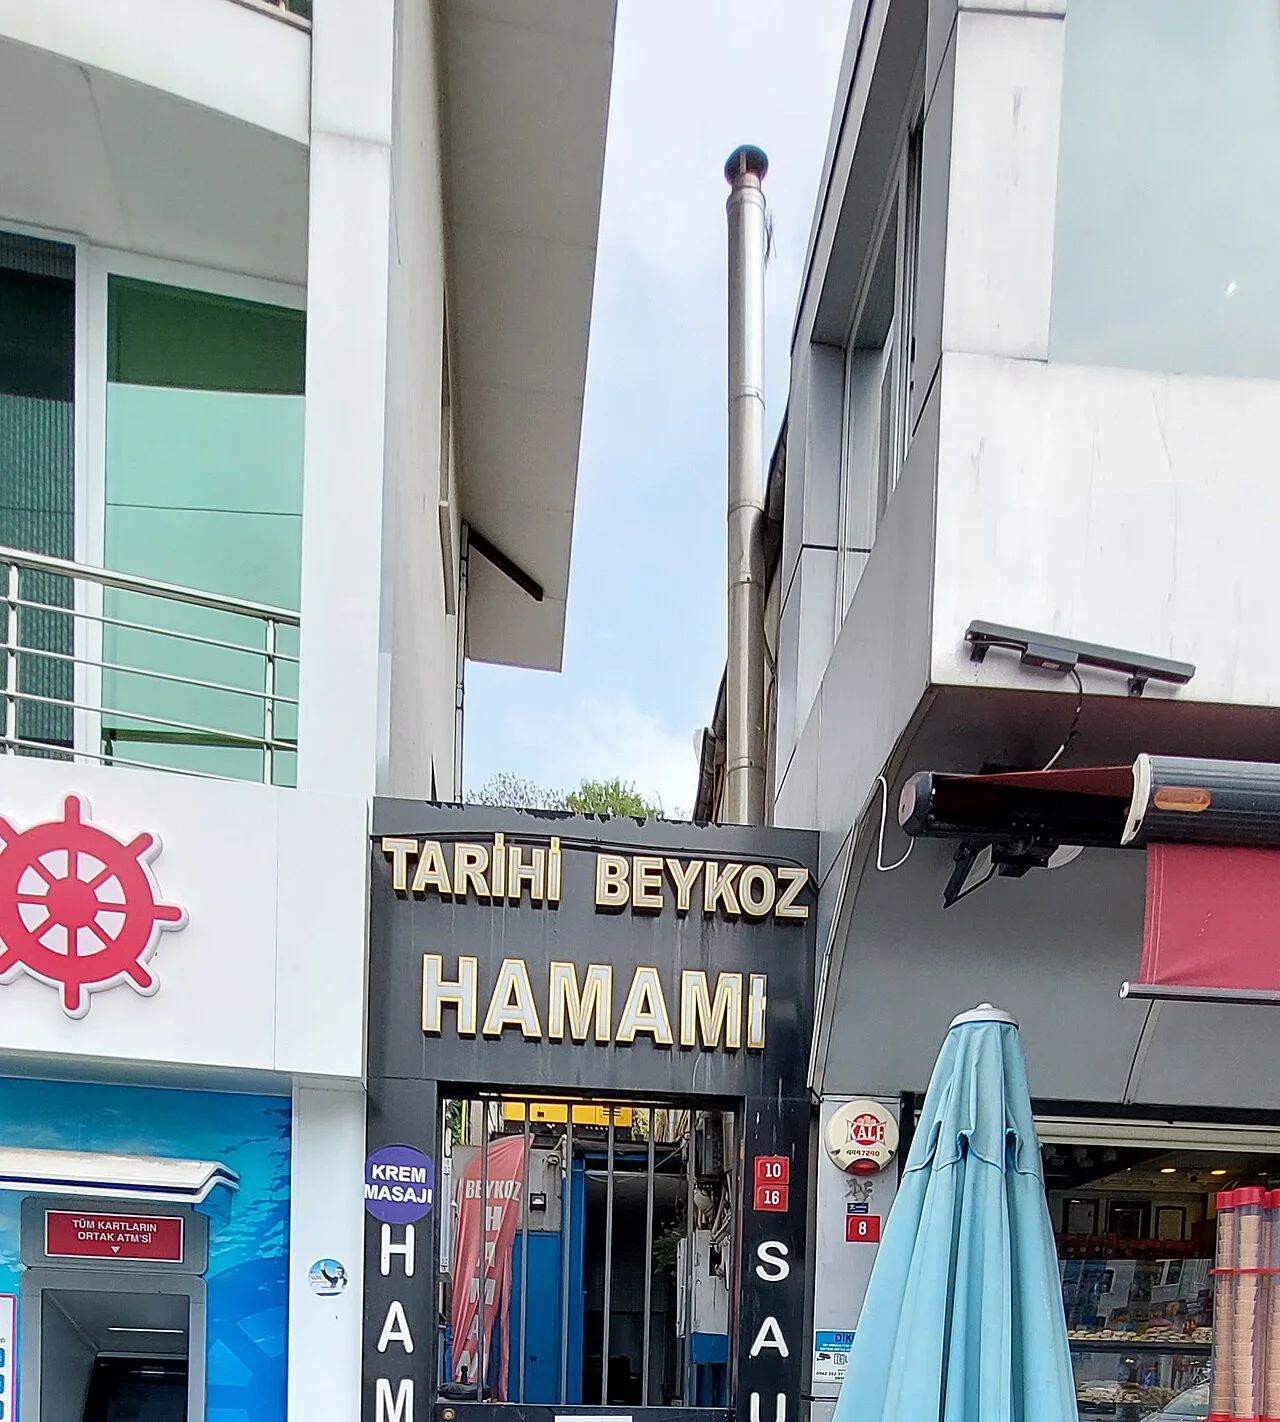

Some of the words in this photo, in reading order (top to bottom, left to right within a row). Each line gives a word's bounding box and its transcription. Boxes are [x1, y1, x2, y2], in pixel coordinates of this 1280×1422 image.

[382, 833, 562, 902] TARİHİ
[596, 854, 810, 919] BEYKOZ
[421, 953, 767, 1049] HAMAMI
[846, 1120, 887, 1145] KALE
[371, 1164, 427, 1184] KREM
[765, 1163, 782, 1178] 10
[363, 1183, 433, 1204] MASAJI
[465, 1179, 522, 1201] BEYKOZ
[763, 1190, 780, 1205] 16
[72, 1217, 95, 1229] TÜM
[97, 1221, 157, 1232] KARTLARIN
[858, 1220, 867, 1236] 8
[77, 1231, 114, 1242] ORTAK
[116, 1232, 152, 1244] ATM'Sİ
